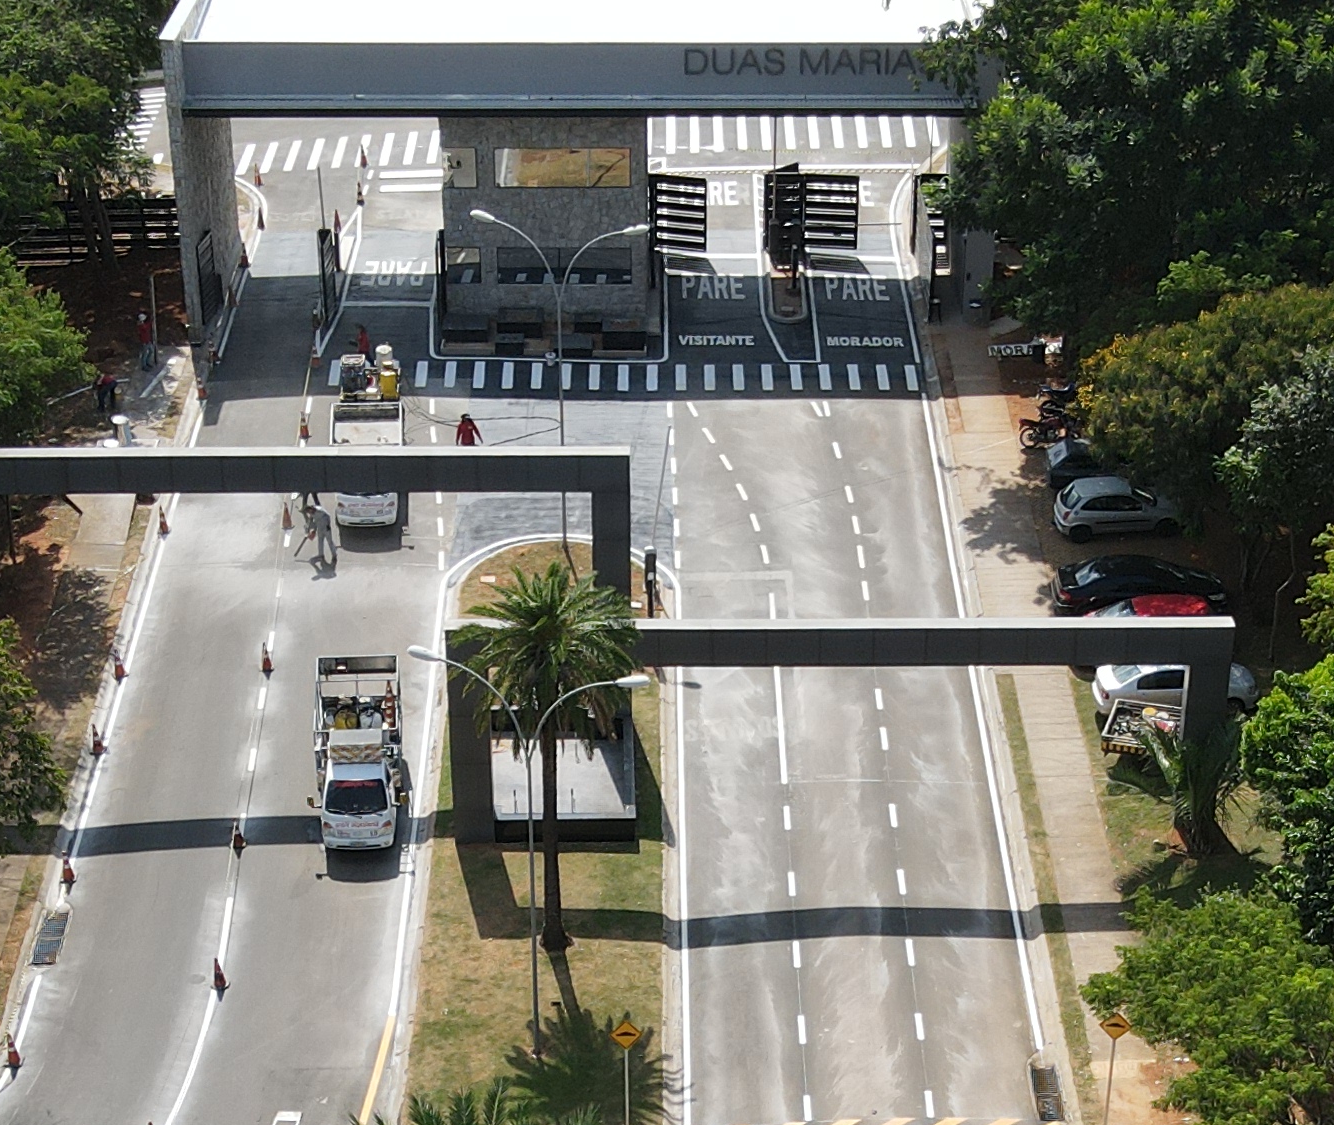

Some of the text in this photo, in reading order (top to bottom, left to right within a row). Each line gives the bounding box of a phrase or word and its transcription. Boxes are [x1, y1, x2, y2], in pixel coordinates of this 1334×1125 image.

[683, 47, 933, 77] DUAS MARIA
[706, 181, 739, 206] RE
[360, 261, 427, 286] PARE
[681, 274, 747, 300] PARE
[824, 275, 891, 301] PARE
[678, 335, 754, 347] VISITANTE
[826, 336, 905, 348] MORADOR
